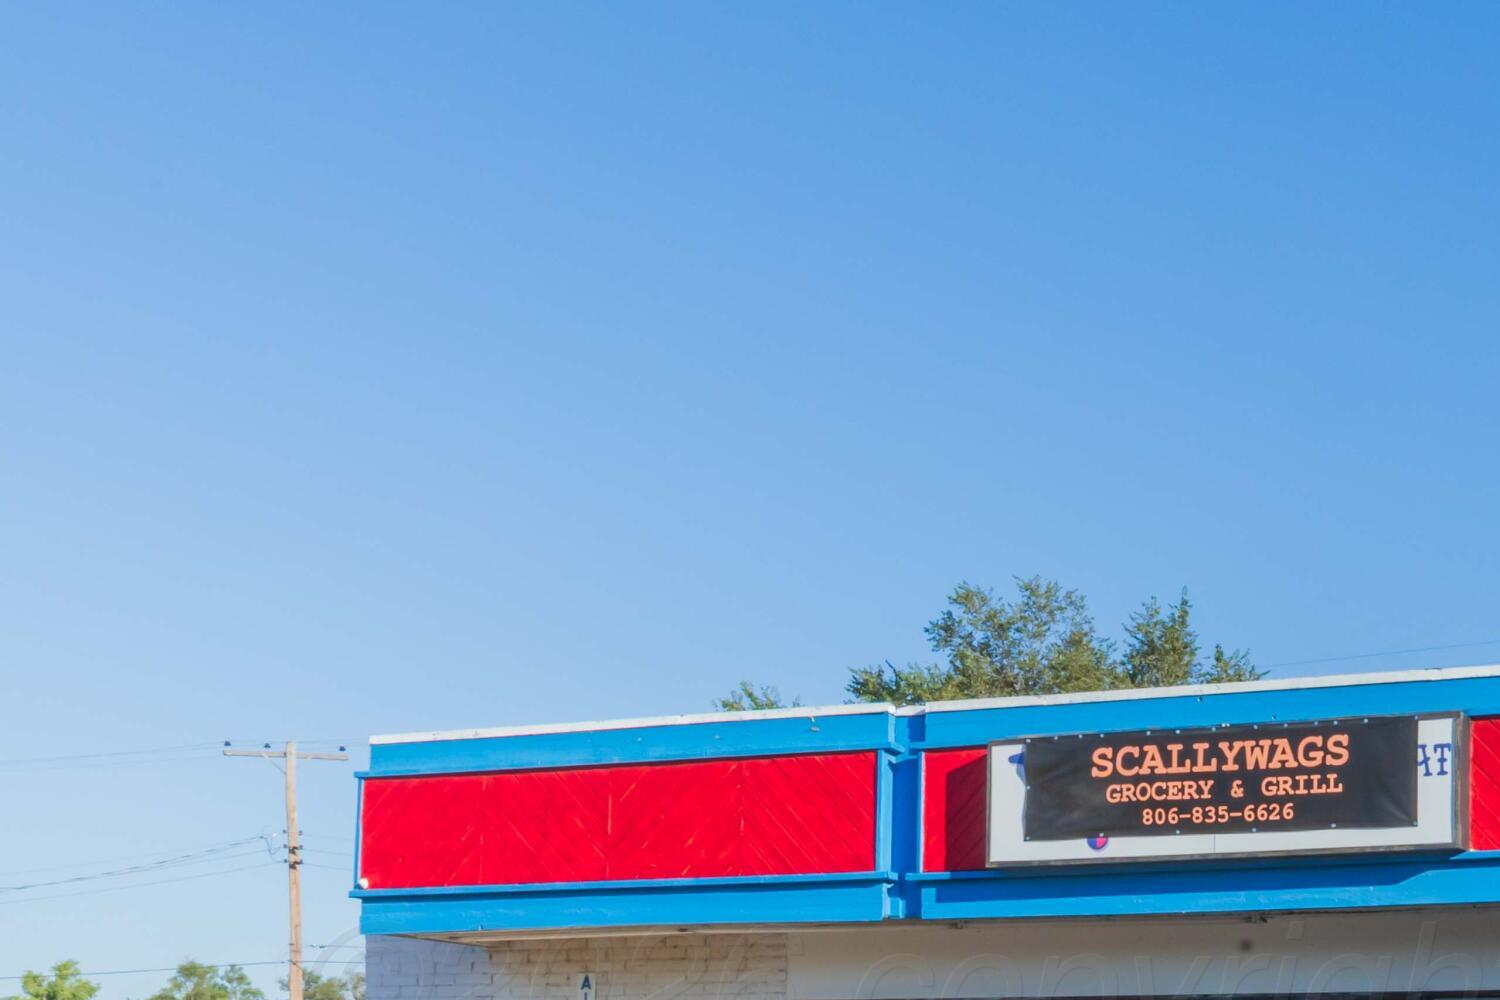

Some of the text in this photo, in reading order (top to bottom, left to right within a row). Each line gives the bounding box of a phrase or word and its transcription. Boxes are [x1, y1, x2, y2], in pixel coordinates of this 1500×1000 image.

[1090, 733, 1350, 778] SCALLYWAGS
[1105, 772, 1344, 804] GROCERY & GRILL
[1142, 802, 1294, 826] 806-835-6626
